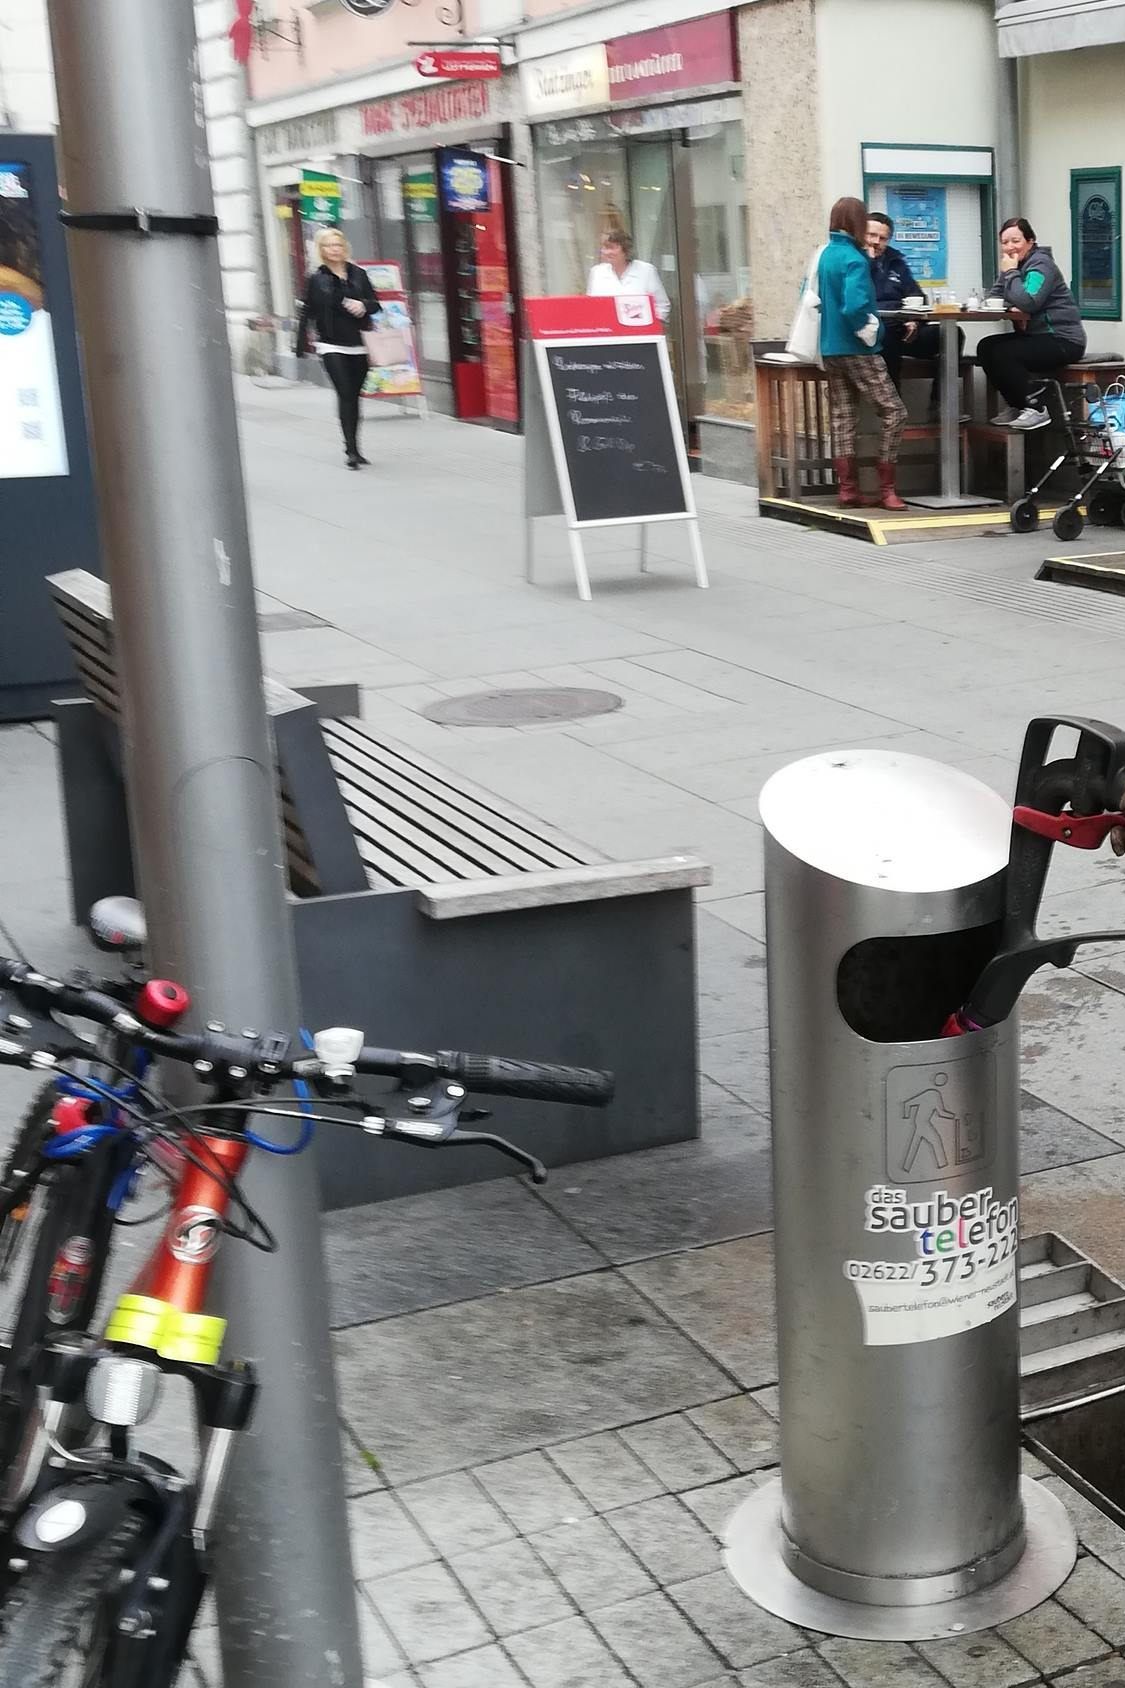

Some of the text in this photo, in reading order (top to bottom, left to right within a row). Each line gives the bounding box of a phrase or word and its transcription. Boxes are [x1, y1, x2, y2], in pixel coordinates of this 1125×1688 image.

[870, 1189, 992, 1230] sauber
[871, 1187, 904, 1204] das
[920, 1203, 1018, 1255] telefon
